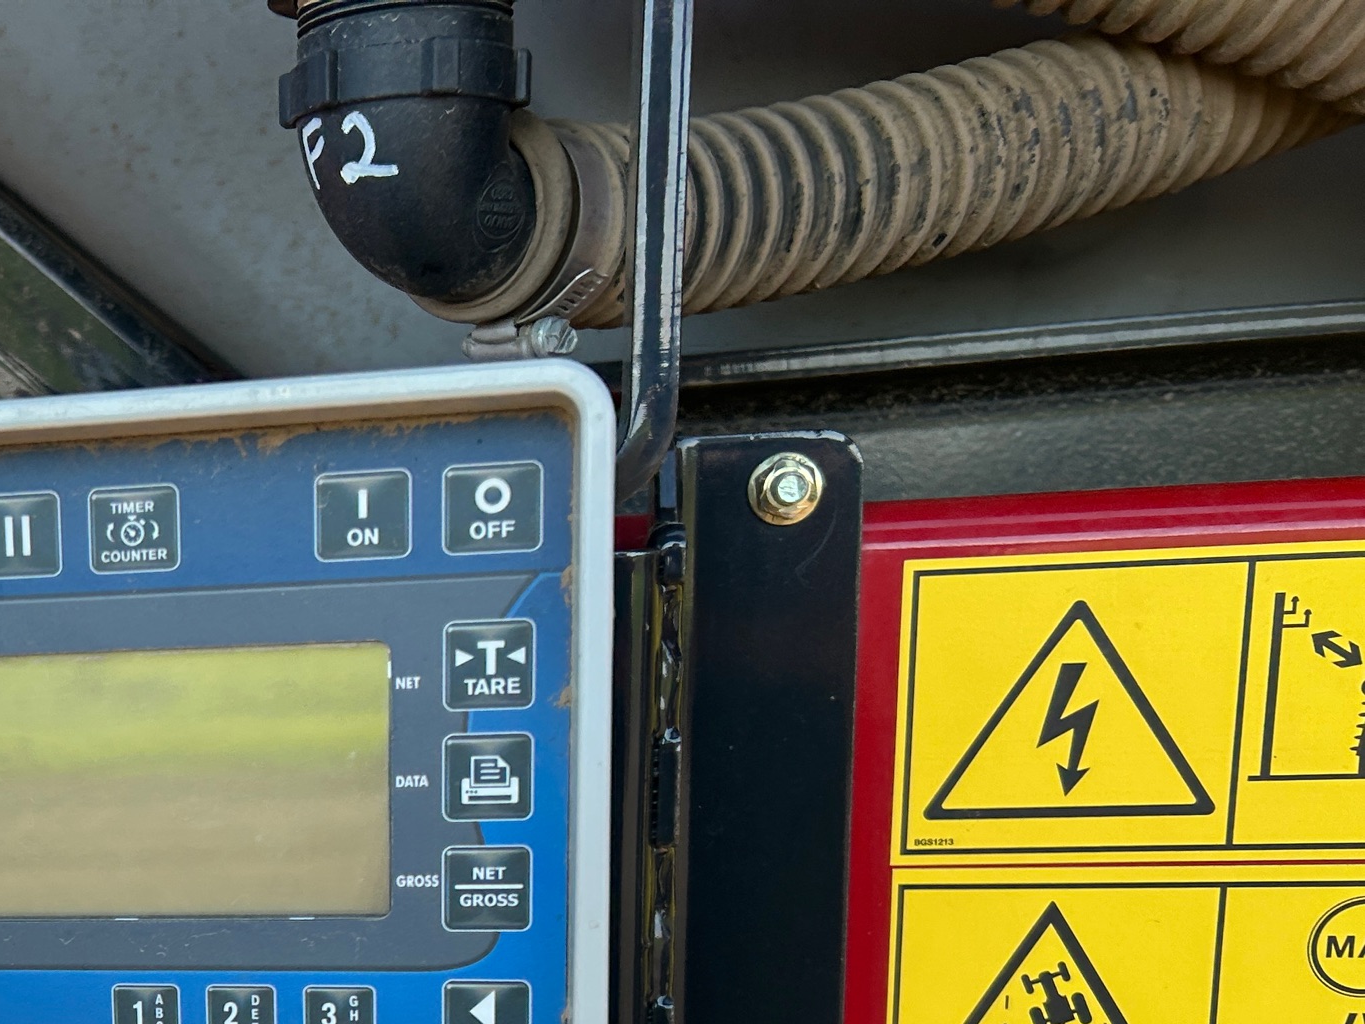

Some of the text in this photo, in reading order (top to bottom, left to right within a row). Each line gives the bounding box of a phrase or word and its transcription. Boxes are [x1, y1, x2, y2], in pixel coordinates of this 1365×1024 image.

[109, 500, 155, 516] TIMER
[346, 527, 379, 547] ON
[469, 520, 516, 540] OFF
[100, 547, 168, 564] COUNTER
[395, 676, 421, 690] NET
[463, 677, 521, 696] TARE
[395, 774, 429, 788] DATA
[395, 874, 440, 888] GROSS
[472, 866, 507, 881] NET
[459, 891, 520, 907] GROSS
